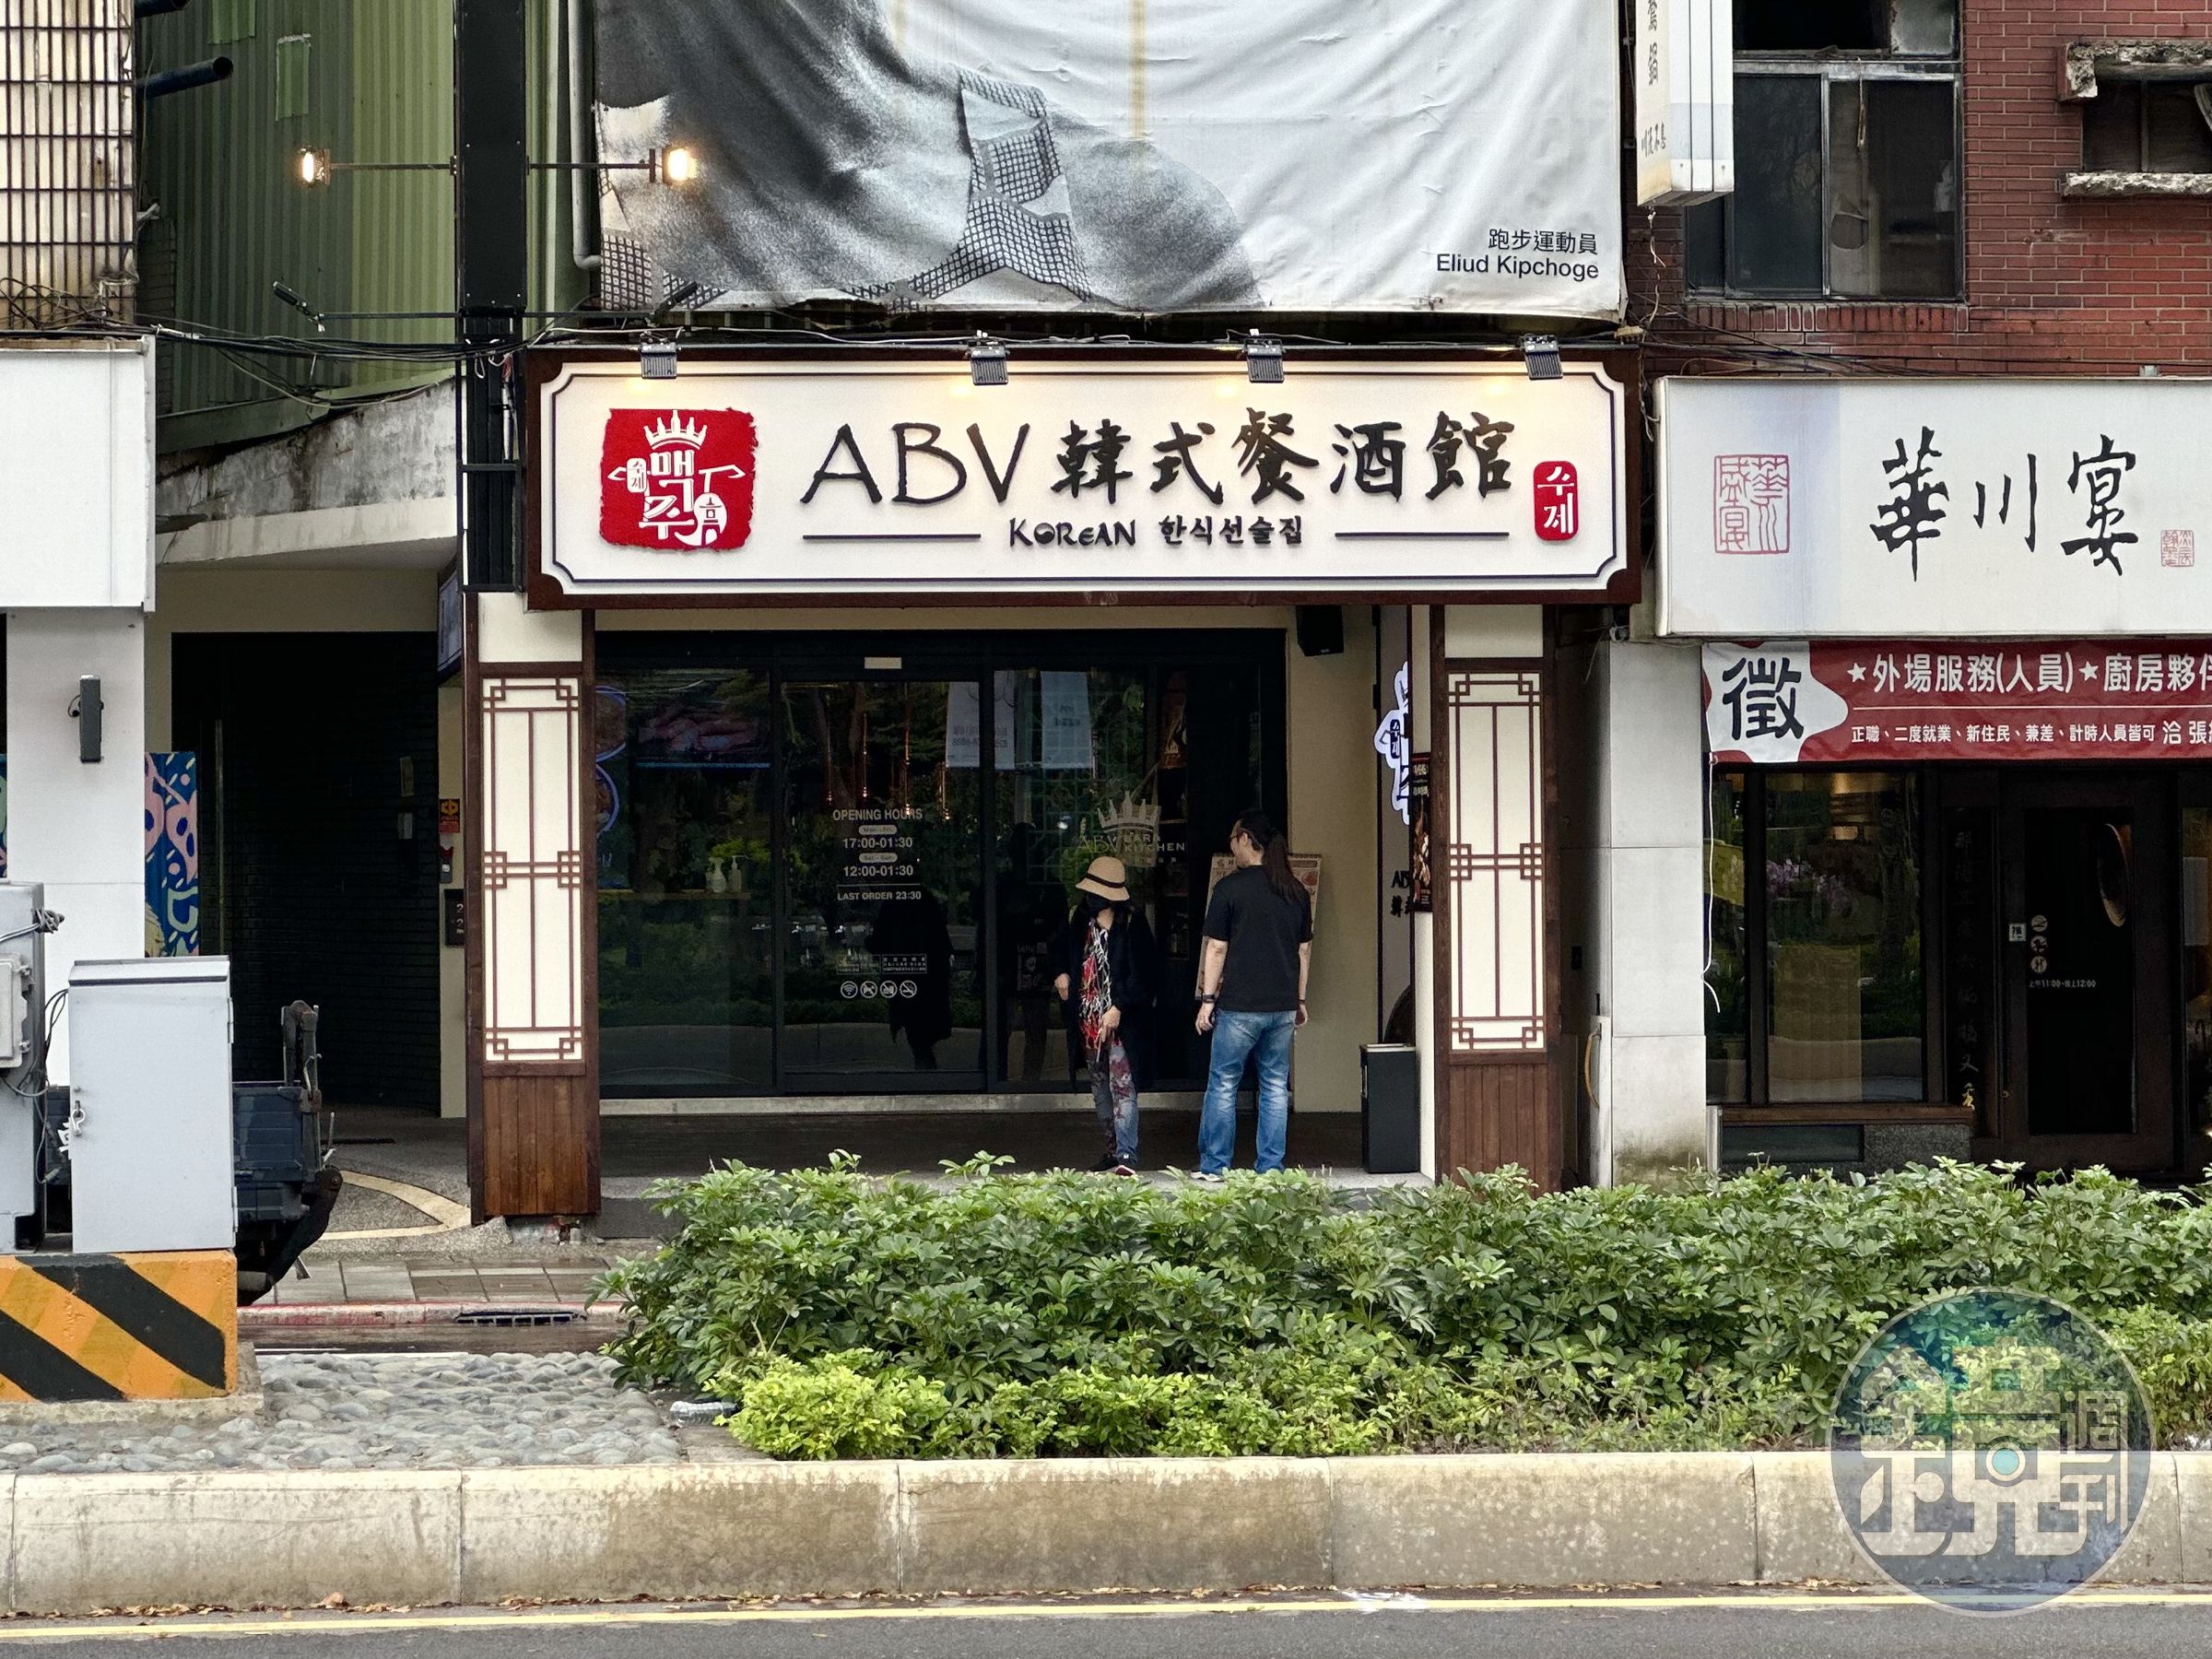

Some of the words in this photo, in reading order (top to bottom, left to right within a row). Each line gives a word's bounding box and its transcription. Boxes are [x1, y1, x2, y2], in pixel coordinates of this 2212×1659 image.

[1488, 229, 1597, 255] 跑步運動員
[1437, 253, 1488, 273] Eliud
[1497, 255, 1599, 282] Kipchoge
[799, 422, 1030, 505] ABV
[1051, 407, 1515, 505] 韓式餐酒館
[1536, 465, 1575, 535] 수제
[1869, 426, 2139, 582] 華川宴
[1159, 515, 1302, 546] 한식선술집
[1722, 656, 1805, 740] 徵
[2162, 721, 2182, 745] 洽
[832, 809, 882, 821] OPENING
[885, 808, 924, 820] HOURS
[842, 837, 914, 849] 17:00-01:30
[843, 865, 915, 877] 12:00-01:30
[837, 892, 859, 901] LAST
[862, 891, 892, 900] ORDER
[895, 890, 922, 900] 23:30
